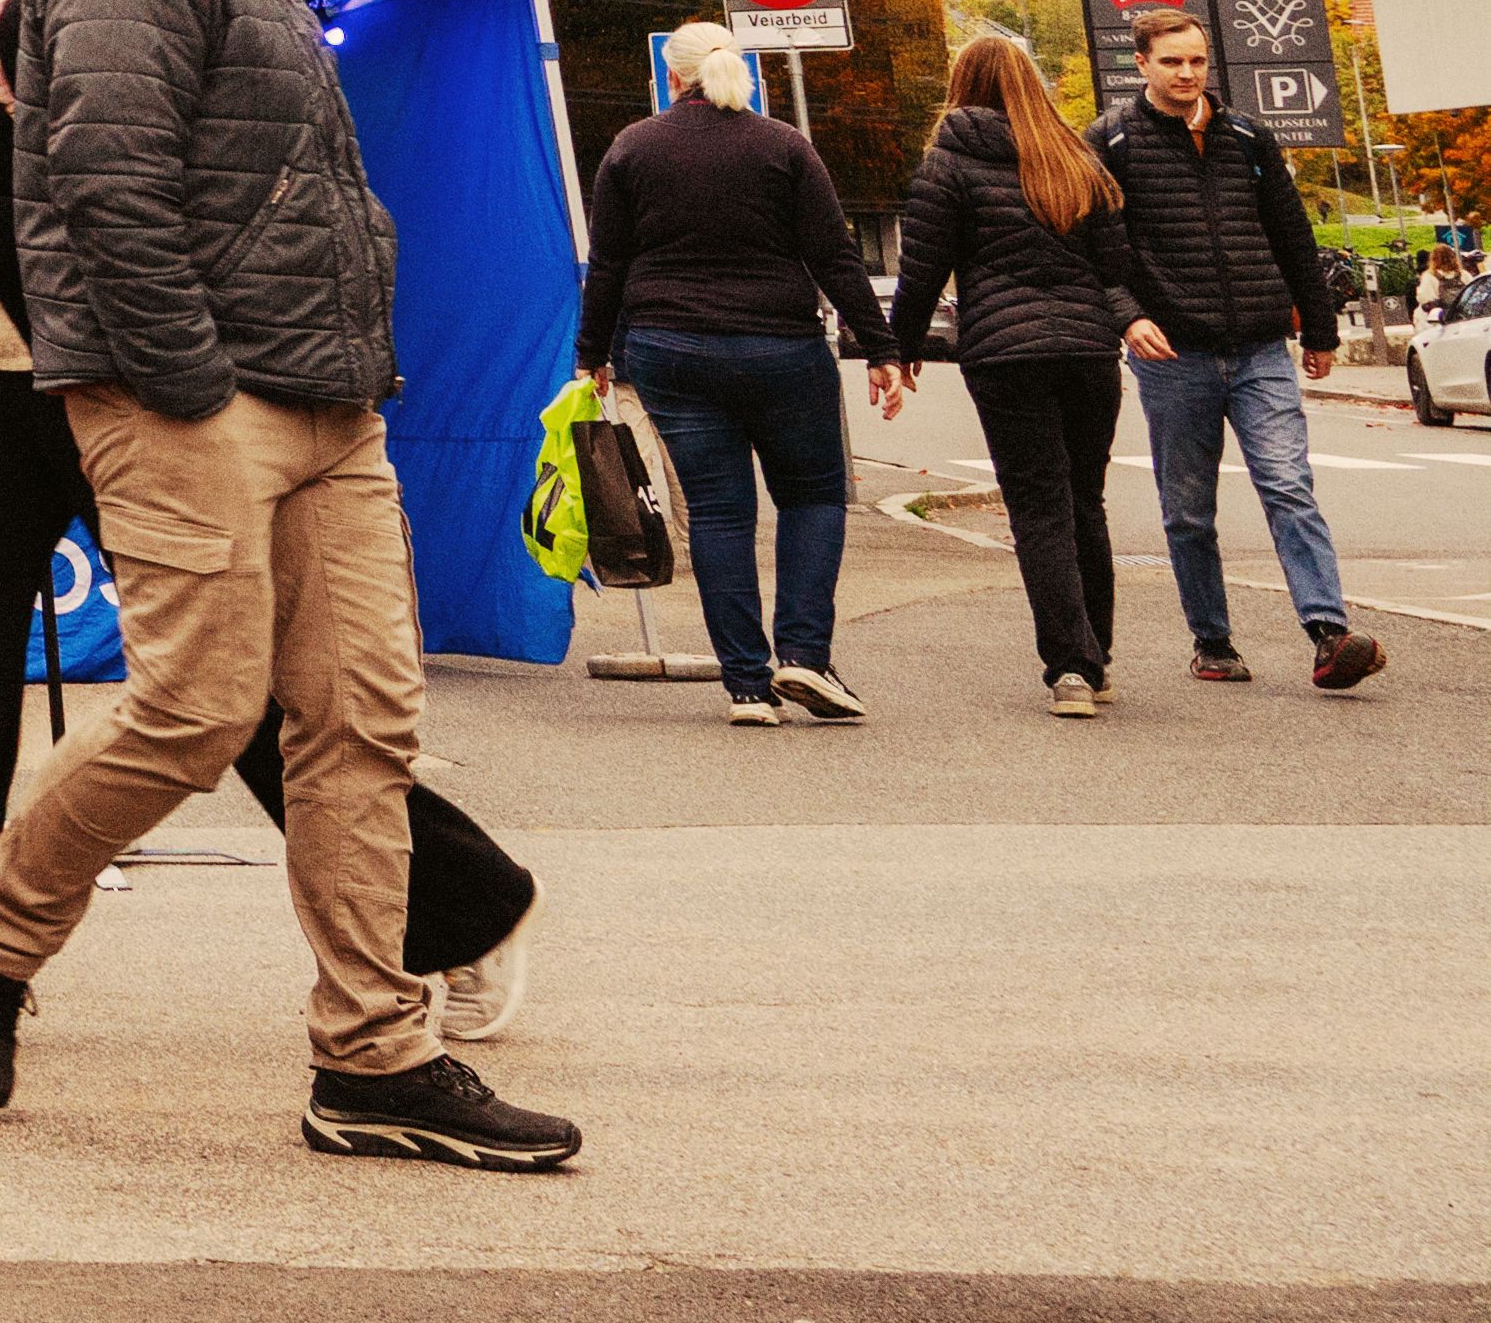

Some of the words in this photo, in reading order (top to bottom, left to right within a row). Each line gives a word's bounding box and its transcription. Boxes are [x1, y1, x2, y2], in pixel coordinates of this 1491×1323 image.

[748, 11, 828, 27] Veiarbeid
[1270, 76, 1298, 108] P
[1263, 117, 1328, 129] OLOSSEUM
